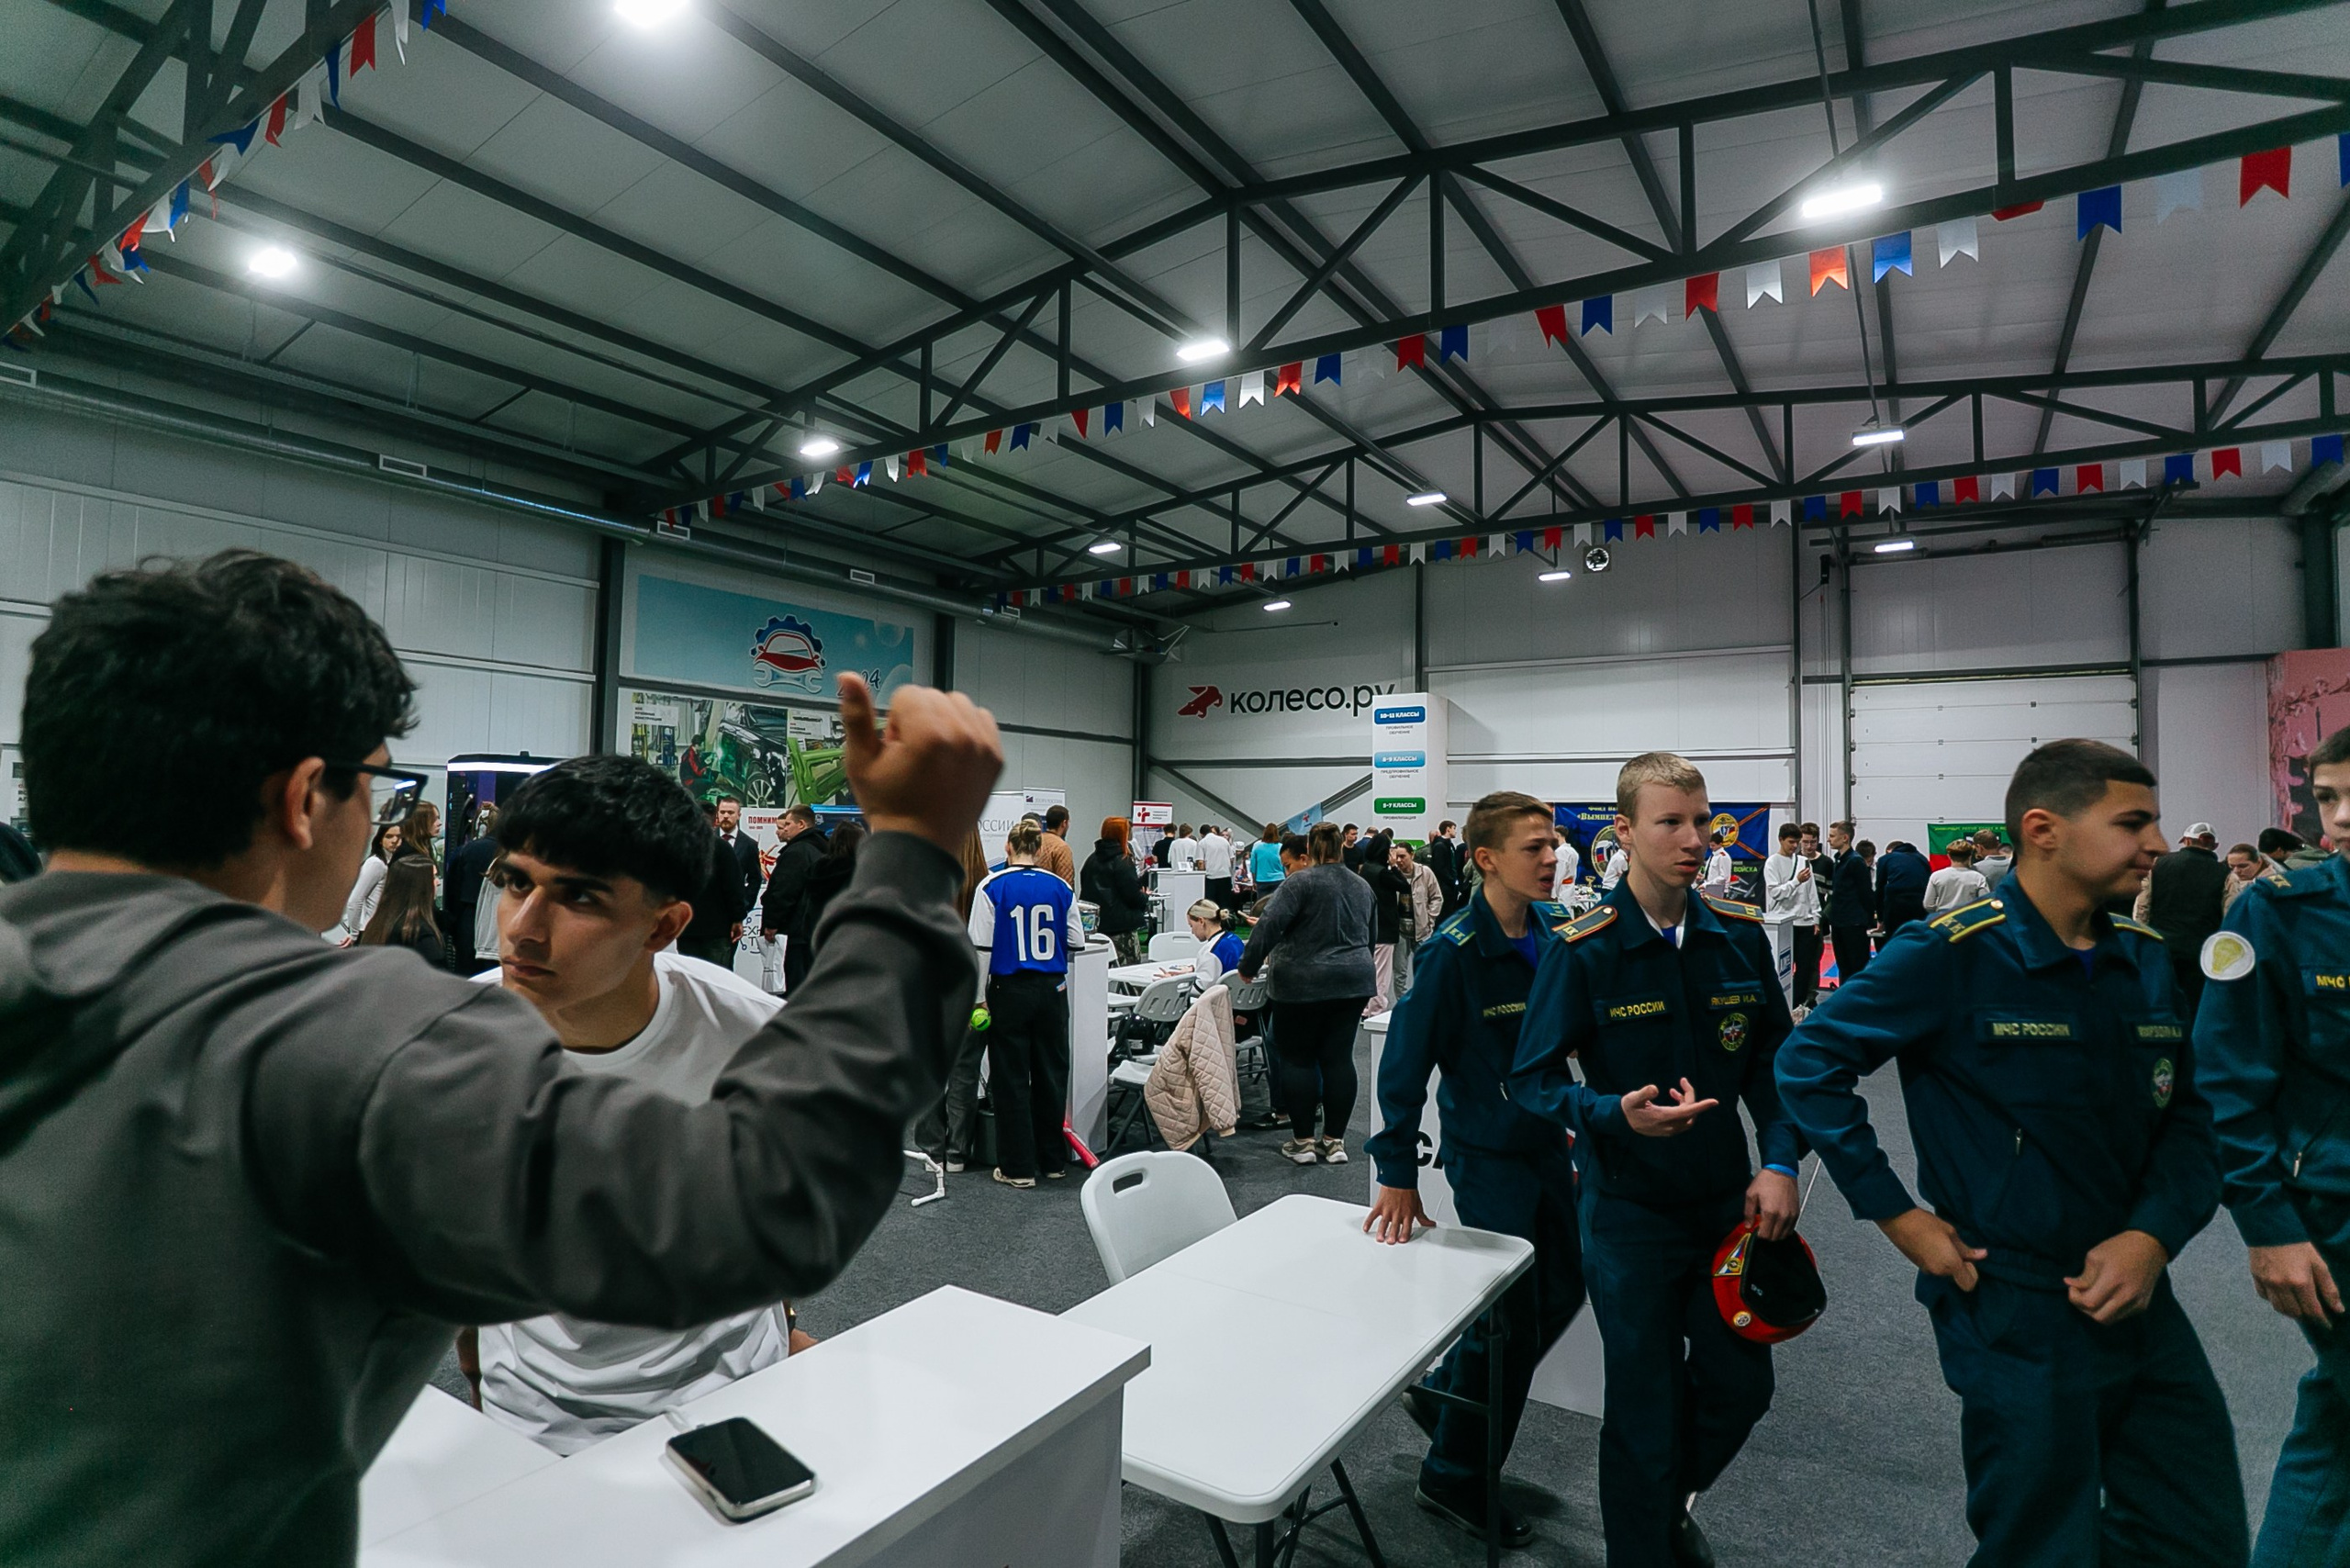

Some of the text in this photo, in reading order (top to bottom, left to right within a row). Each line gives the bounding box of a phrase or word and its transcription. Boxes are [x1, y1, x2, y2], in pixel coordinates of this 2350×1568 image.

[977, 819, 1014, 832] ОССИИ
[1010, 904, 1056, 962] 16
[2315, 975, 2345, 990] МЧС
[1627, 1001, 1665, 1016] РОССИИ
[1992, 1023, 2071, 1036] МЧС РОССИИ
